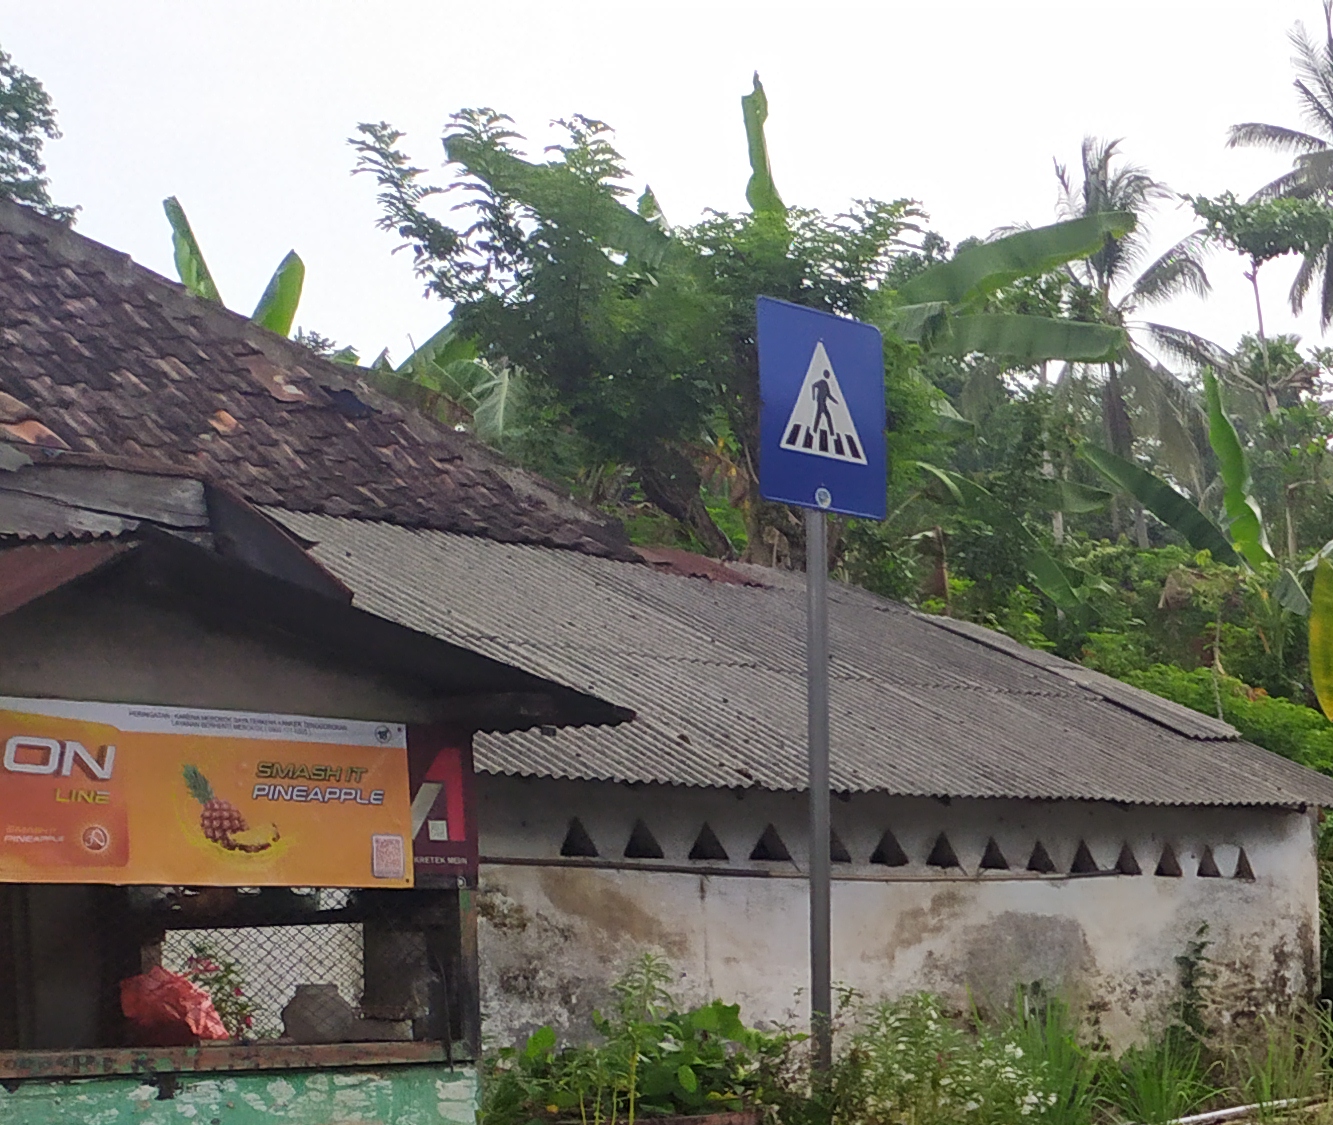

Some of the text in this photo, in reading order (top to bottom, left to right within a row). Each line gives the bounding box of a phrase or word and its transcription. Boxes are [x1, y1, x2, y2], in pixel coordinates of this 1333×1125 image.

[256, 760, 369, 784] SMASH IT
[55, 787, 110, 804] LINE
[252, 783, 386, 806] PINEAPPLE
